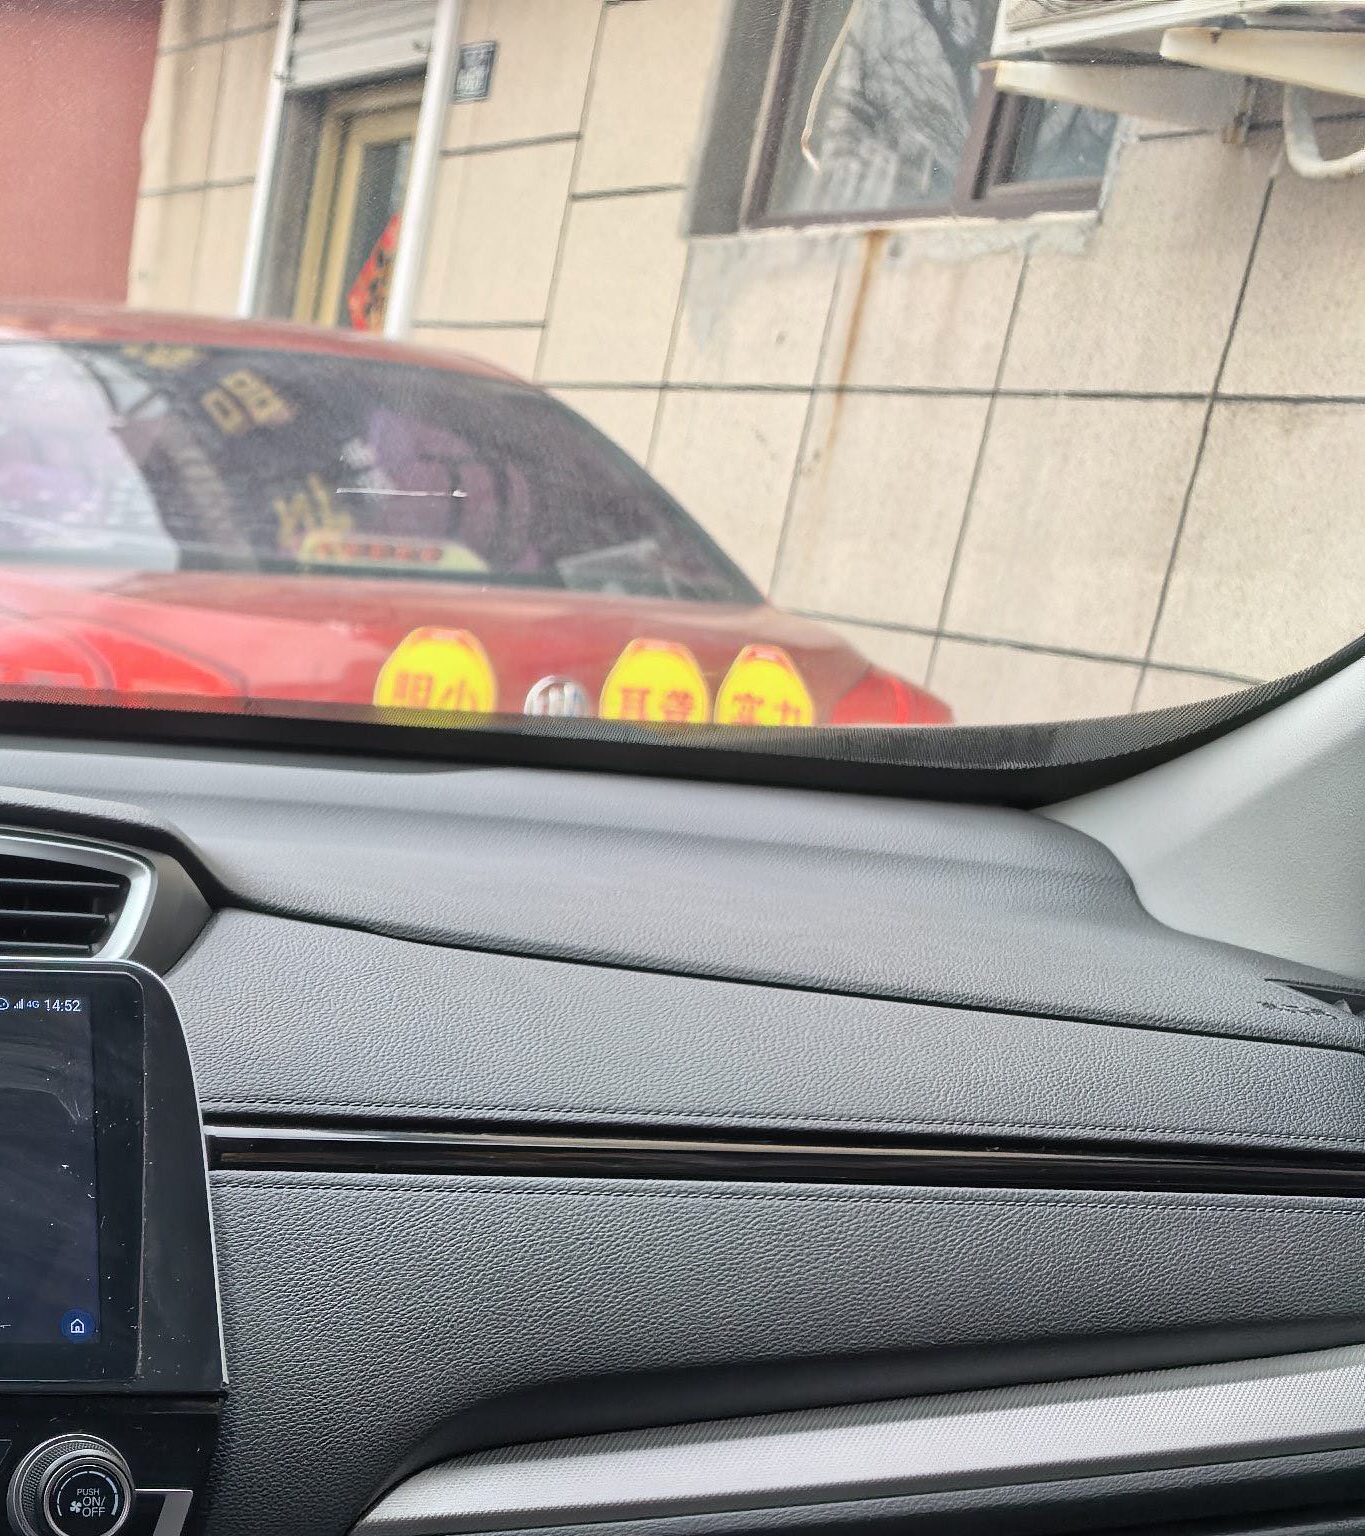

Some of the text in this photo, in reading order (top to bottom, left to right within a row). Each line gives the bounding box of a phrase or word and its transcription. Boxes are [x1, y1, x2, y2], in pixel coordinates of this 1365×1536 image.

[26, 999, 81, 1013] 4G 14:52
[82, 1507, 106, 1518] OFF
